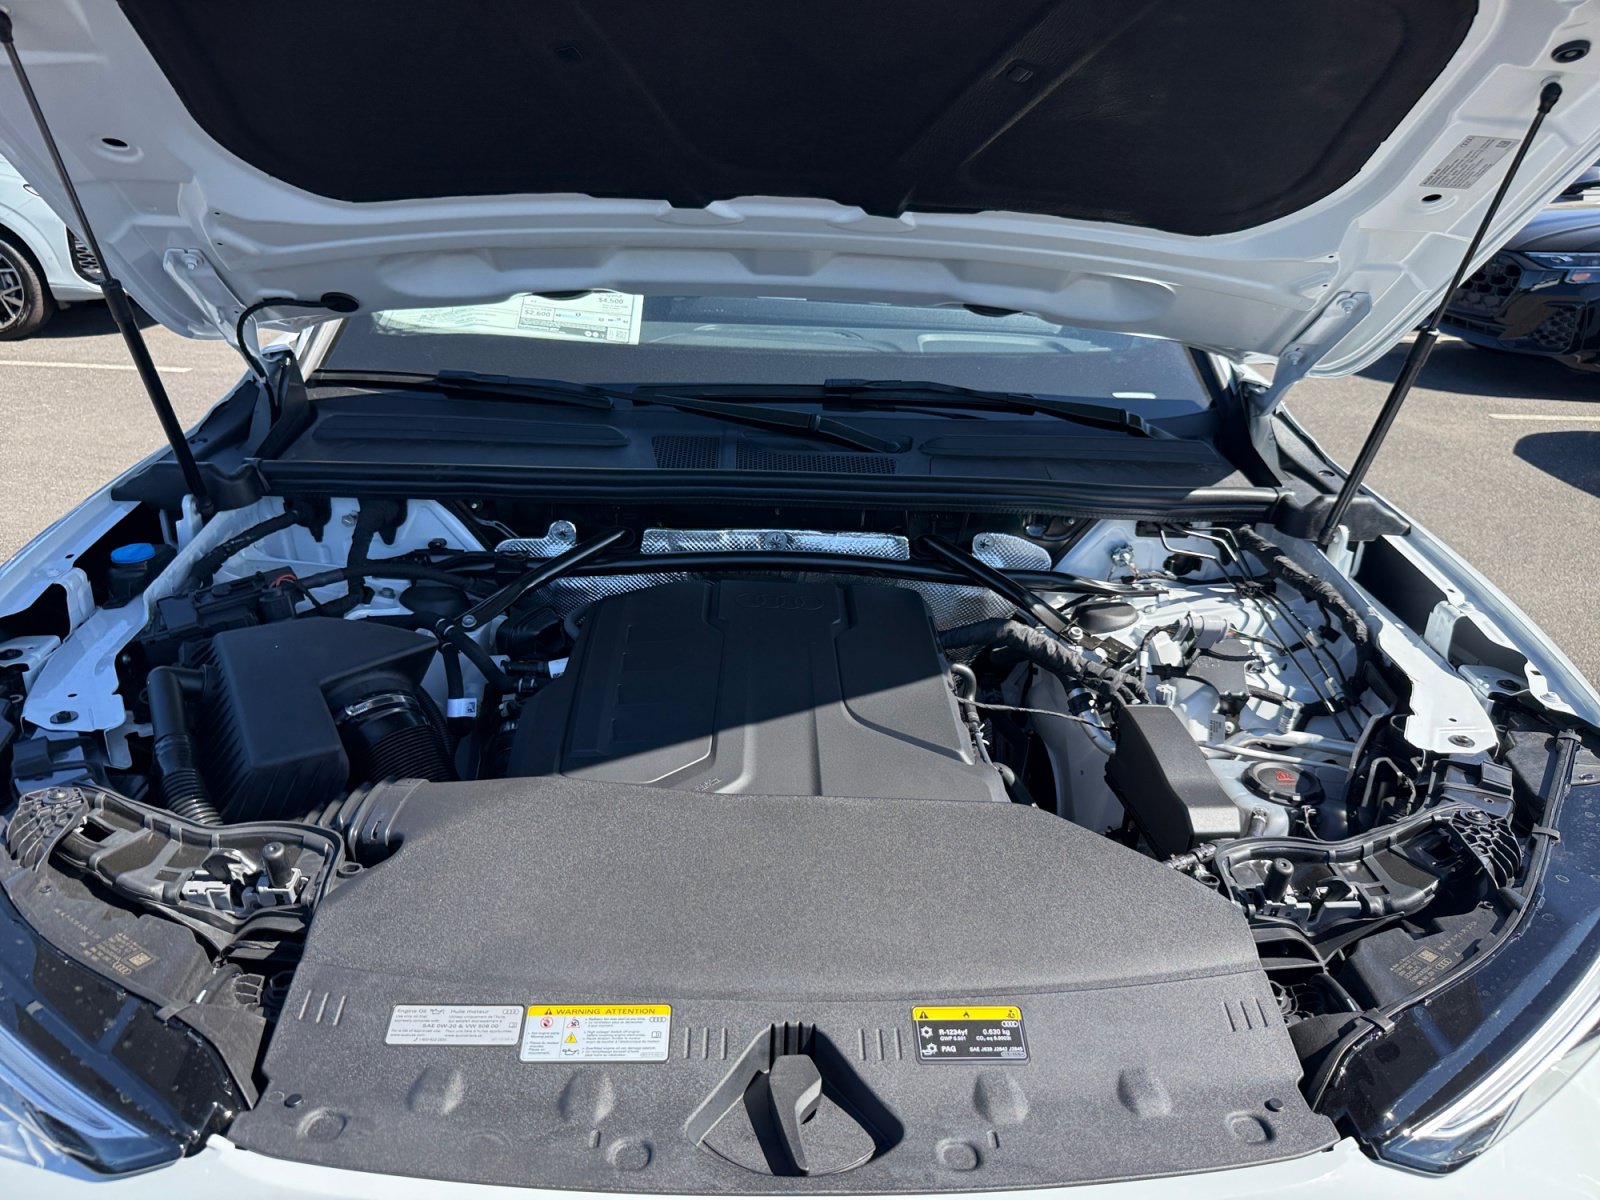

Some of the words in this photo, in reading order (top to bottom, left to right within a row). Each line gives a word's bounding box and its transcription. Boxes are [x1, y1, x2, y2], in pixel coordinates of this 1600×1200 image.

[938, 1028, 968, 1036] R-1234yf
[1001, 1028, 1011, 1036] kg
[941, 1045, 957, 1053] PAG
